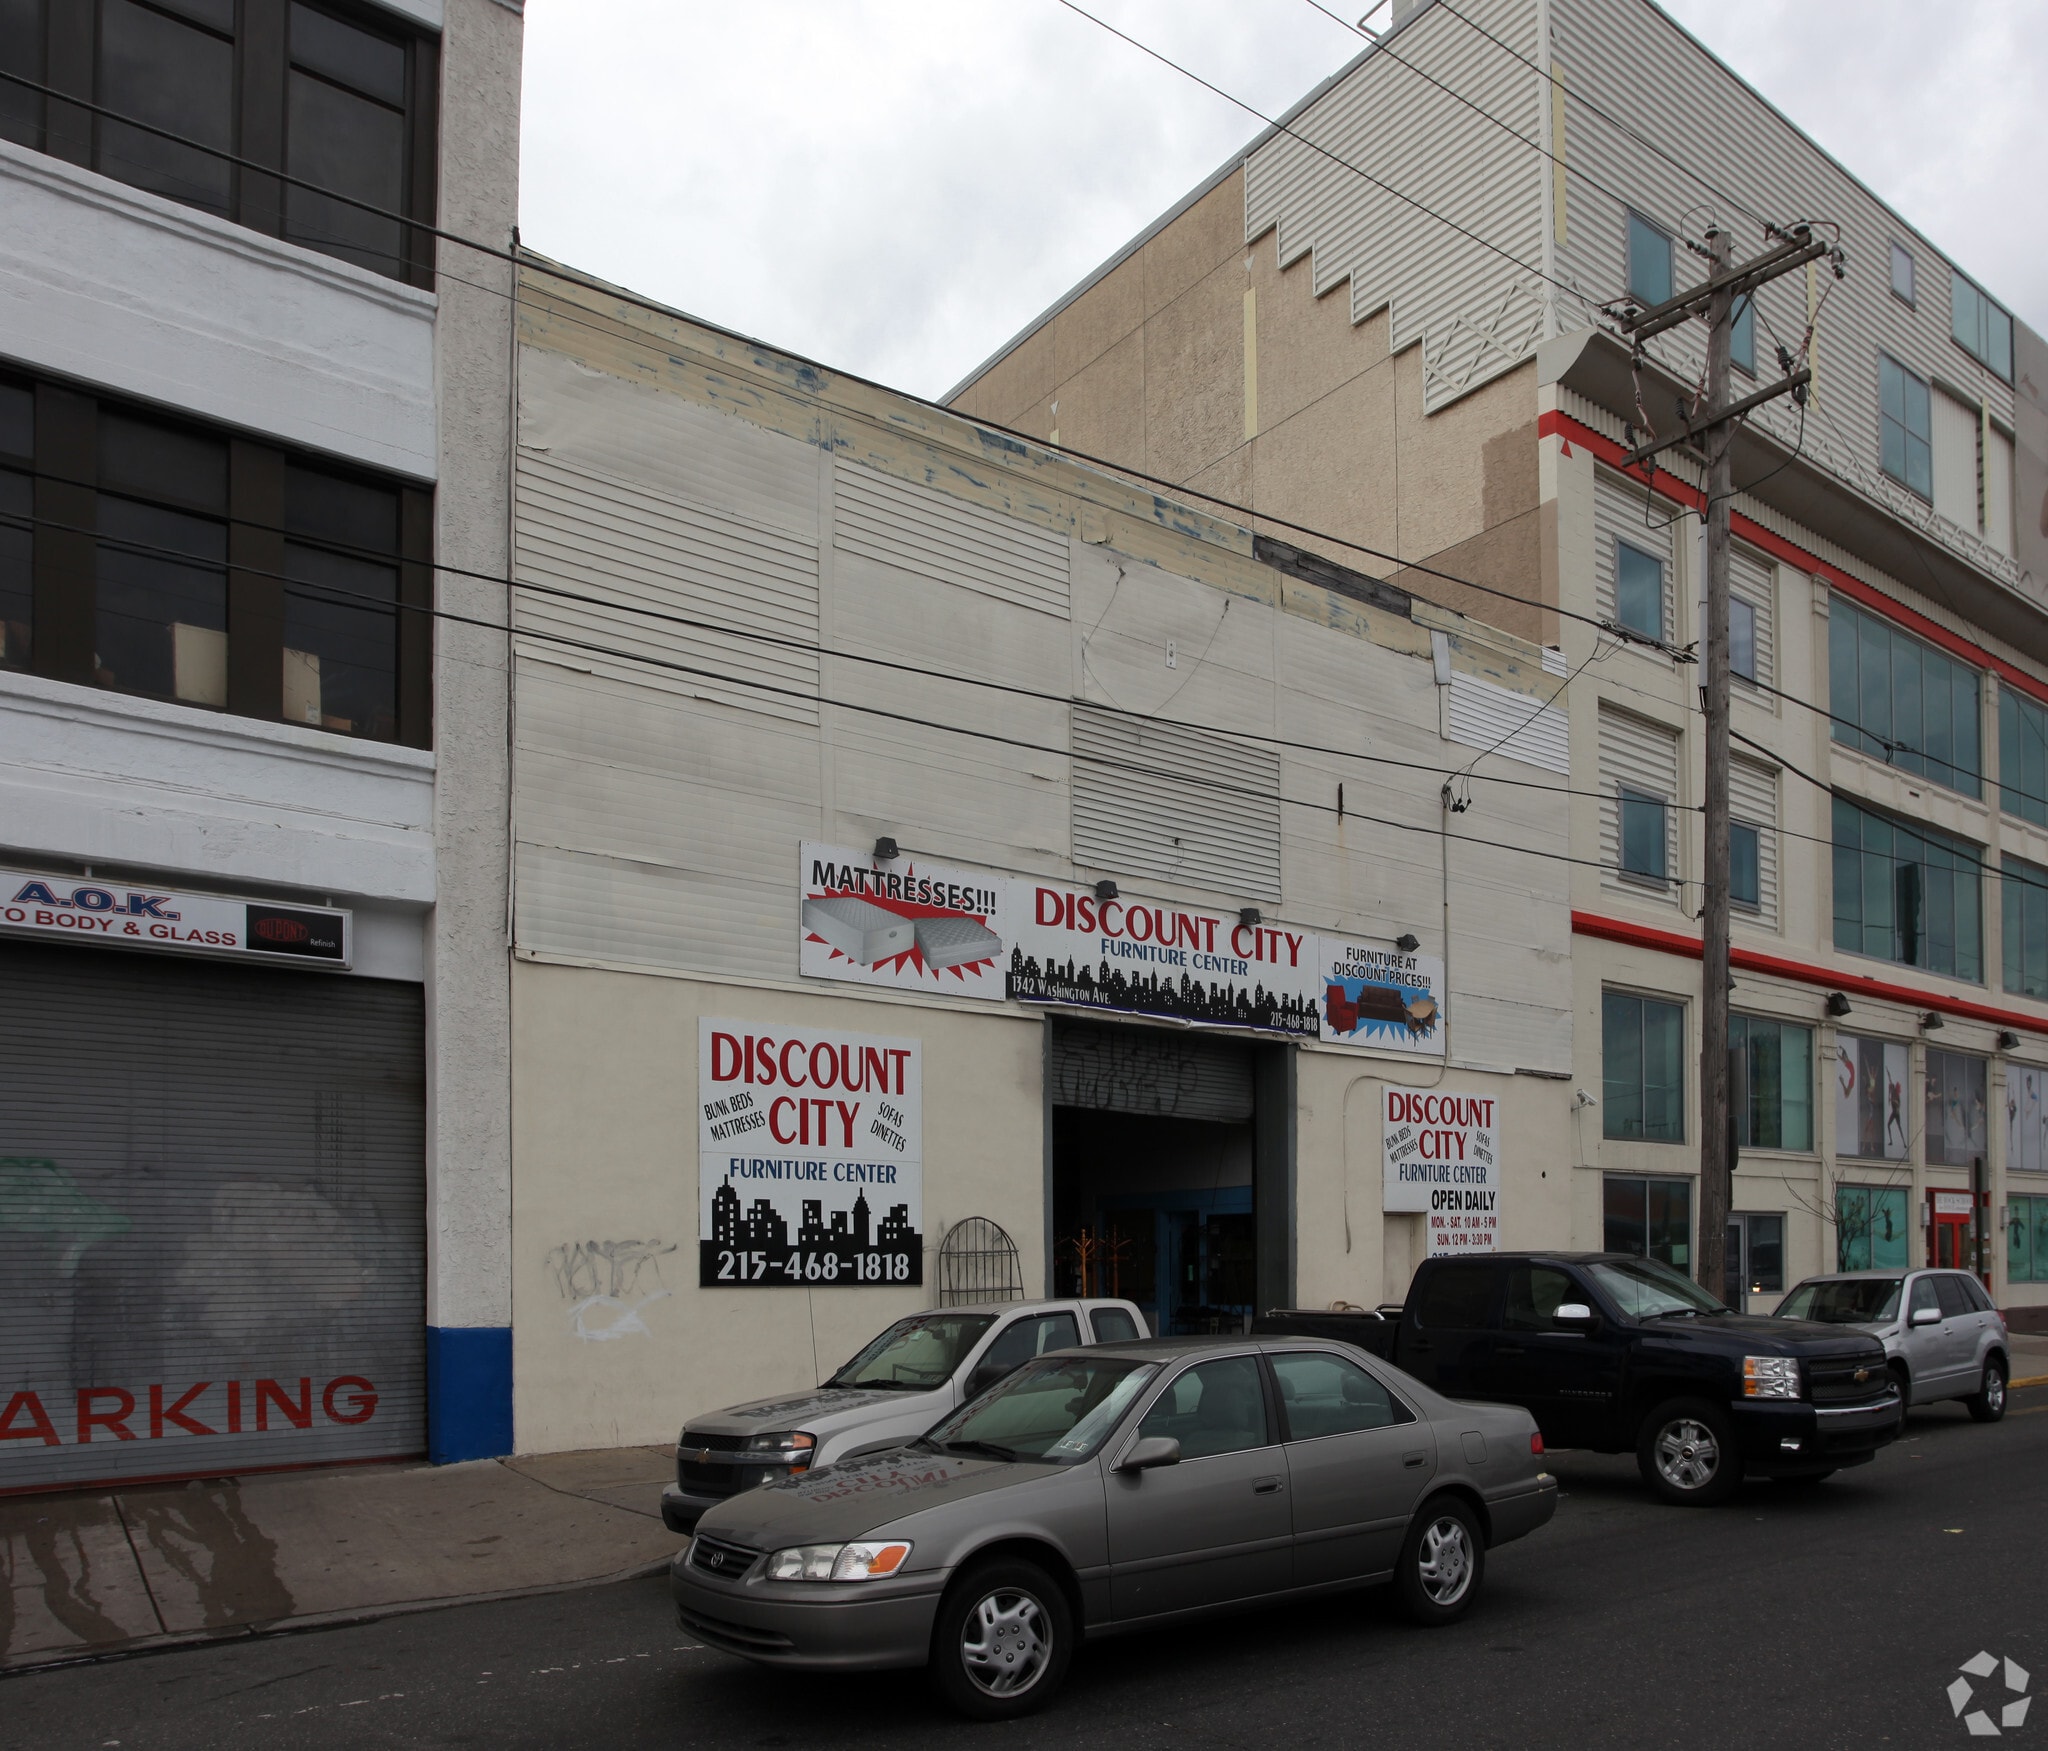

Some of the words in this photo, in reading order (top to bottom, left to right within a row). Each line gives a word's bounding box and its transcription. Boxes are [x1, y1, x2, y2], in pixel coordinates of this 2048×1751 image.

[11, 880, 181, 921] A.O.K.
[812, 860, 997, 915] MATTRESSES!!!
[35, 910, 114, 932] BODY
[123, 921, 141, 935] &
[149, 924, 237, 946] GLASS
[1035, 887, 1220, 953] DISCOUNT
[1231, 924, 1304, 967] CITY
[310, 938, 336, 948] Refinish
[1101, 938, 1187, 966] FURNITURE
[1192, 953, 1248, 976] CENTER
[1346, 947, 1403, 968] FURNITURE
[1405, 957, 1417, 971] AT
[1011, 975, 1035, 995] 1342
[1333, 961, 1388, 983] DISCOUNT
[1389, 971, 1431, 989] PRICES!!!
[1270, 1011, 1318, 1032] 215-468-1818
[711, 1031, 912, 1095] DISCOUNT
[704, 1098, 730, 1121] BUNK
[729, 1091, 754, 1113] BEDS
[877, 1101, 905, 1129] SOFAS
[1388, 1091, 1495, 1128] DISCOUNT
[710, 1110, 766, 1142] MATTRESSES
[768, 1096, 861, 1148] CITY
[870, 1119, 907, 1153] DINETTES
[1399, 1125, 1412, 1142] BEDS
[1389, 1138, 1418, 1165] MATTRESSES
[1419, 1129, 1467, 1160] CITY
[1475, 1130, 1490, 1148] SOFAS
[1473, 1144, 1493, 1166] DINETTES
[730, 1158, 827, 1181] FURNITURE
[833, 1162, 897, 1184] CENTER
[1400, 1163, 1451, 1183] FURNITURE
[1453, 1166, 1487, 1184] CENTER
[1431, 1189, 1462, 1210] OPEN
[1465, 1190, 1496, 1211] DAILY
[1431, 1216, 1446, 1228] MON.
[1450, 1216, 1461, 1228] SAT.
[1465, 1217, 1471, 1228] 10
[1472, 1217, 1480, 1228] AM
[1489, 1217, 1497, 1228] PM
[1437, 1233, 1451, 1245] SUN.
[1452, 1234, 1459, 1245] 12
[1460, 1234, 1467, 1245] PM
[1484, 1234, 1492, 1245] PM
[717, 1250, 910, 1281] 215-468-1818
